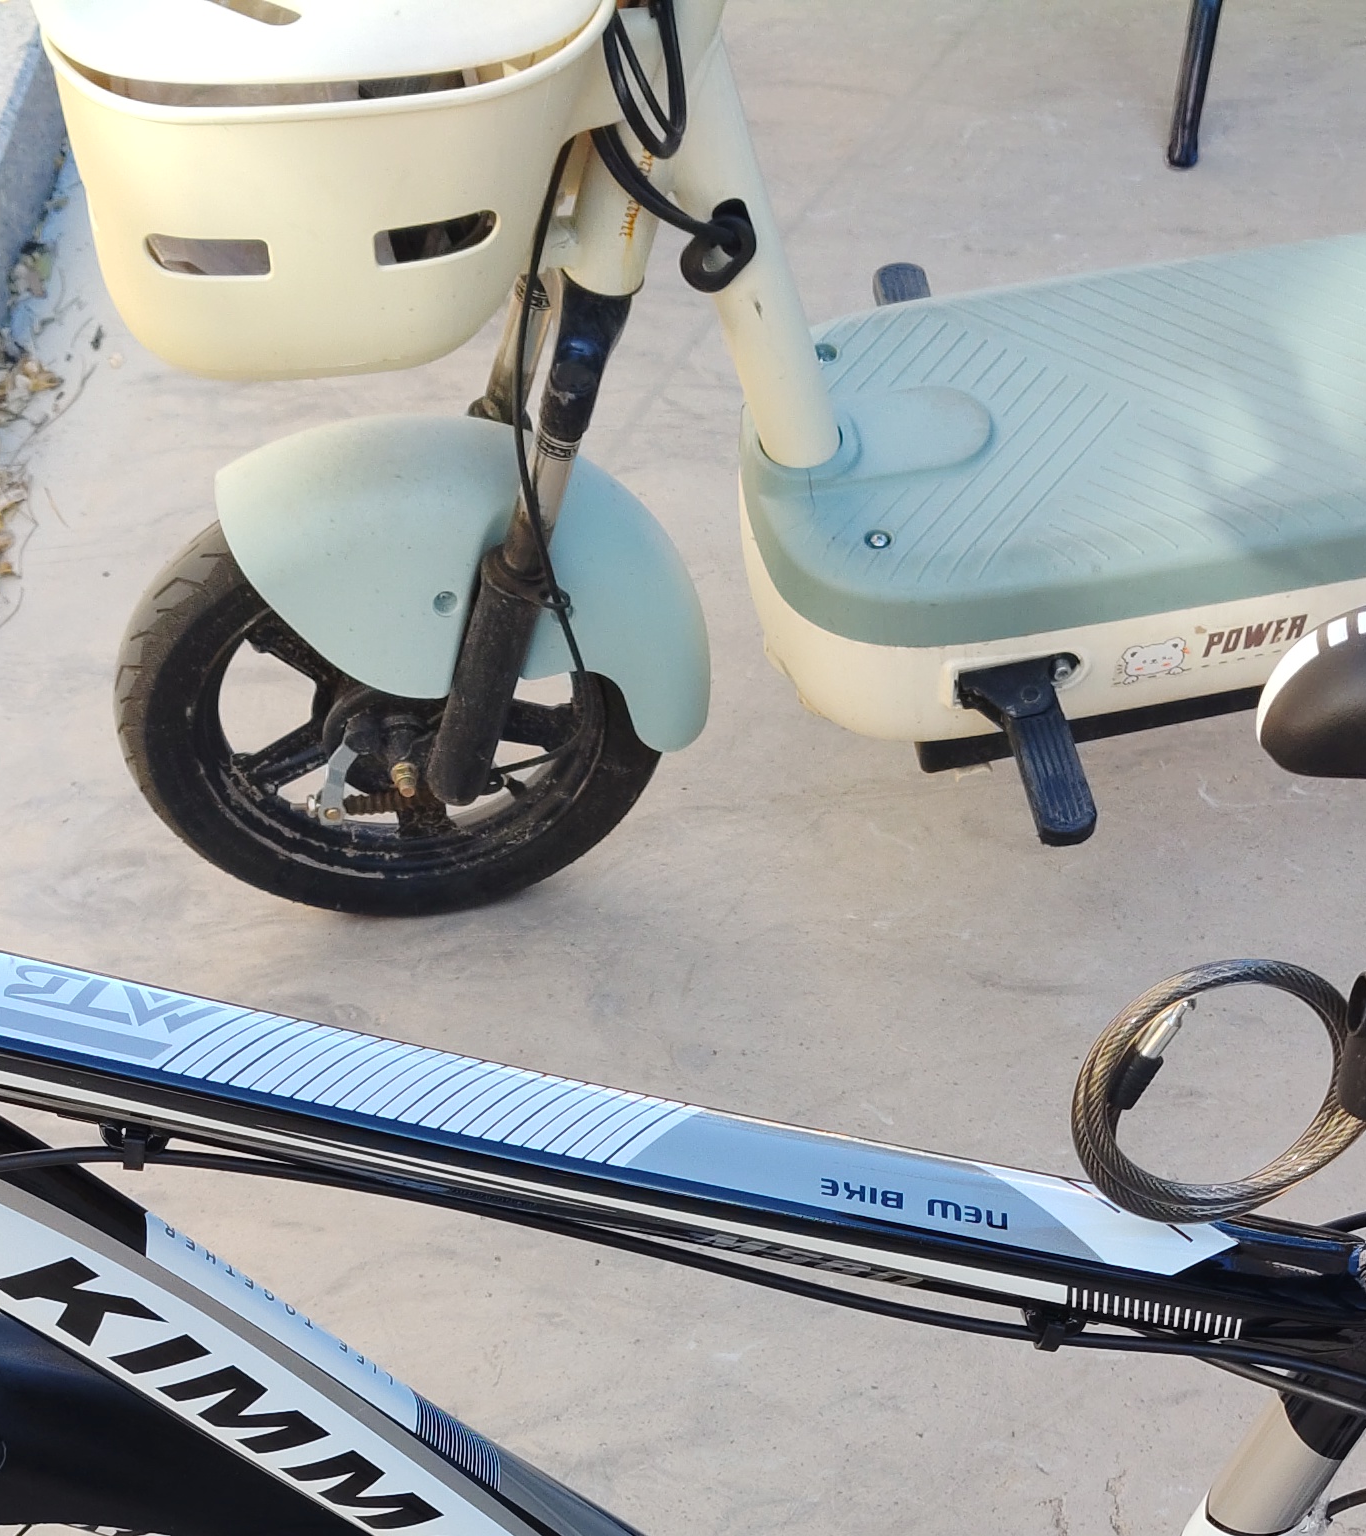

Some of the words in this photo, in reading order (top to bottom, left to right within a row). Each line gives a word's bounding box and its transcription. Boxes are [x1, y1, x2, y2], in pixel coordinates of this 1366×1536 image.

[1202, 614, 1308, 657] POWER
[820, 1178, 904, 1209] BIKE
[164, 1222, 315, 1330] TOGETHER
[339, 1338, 395, 1385] LIFE
